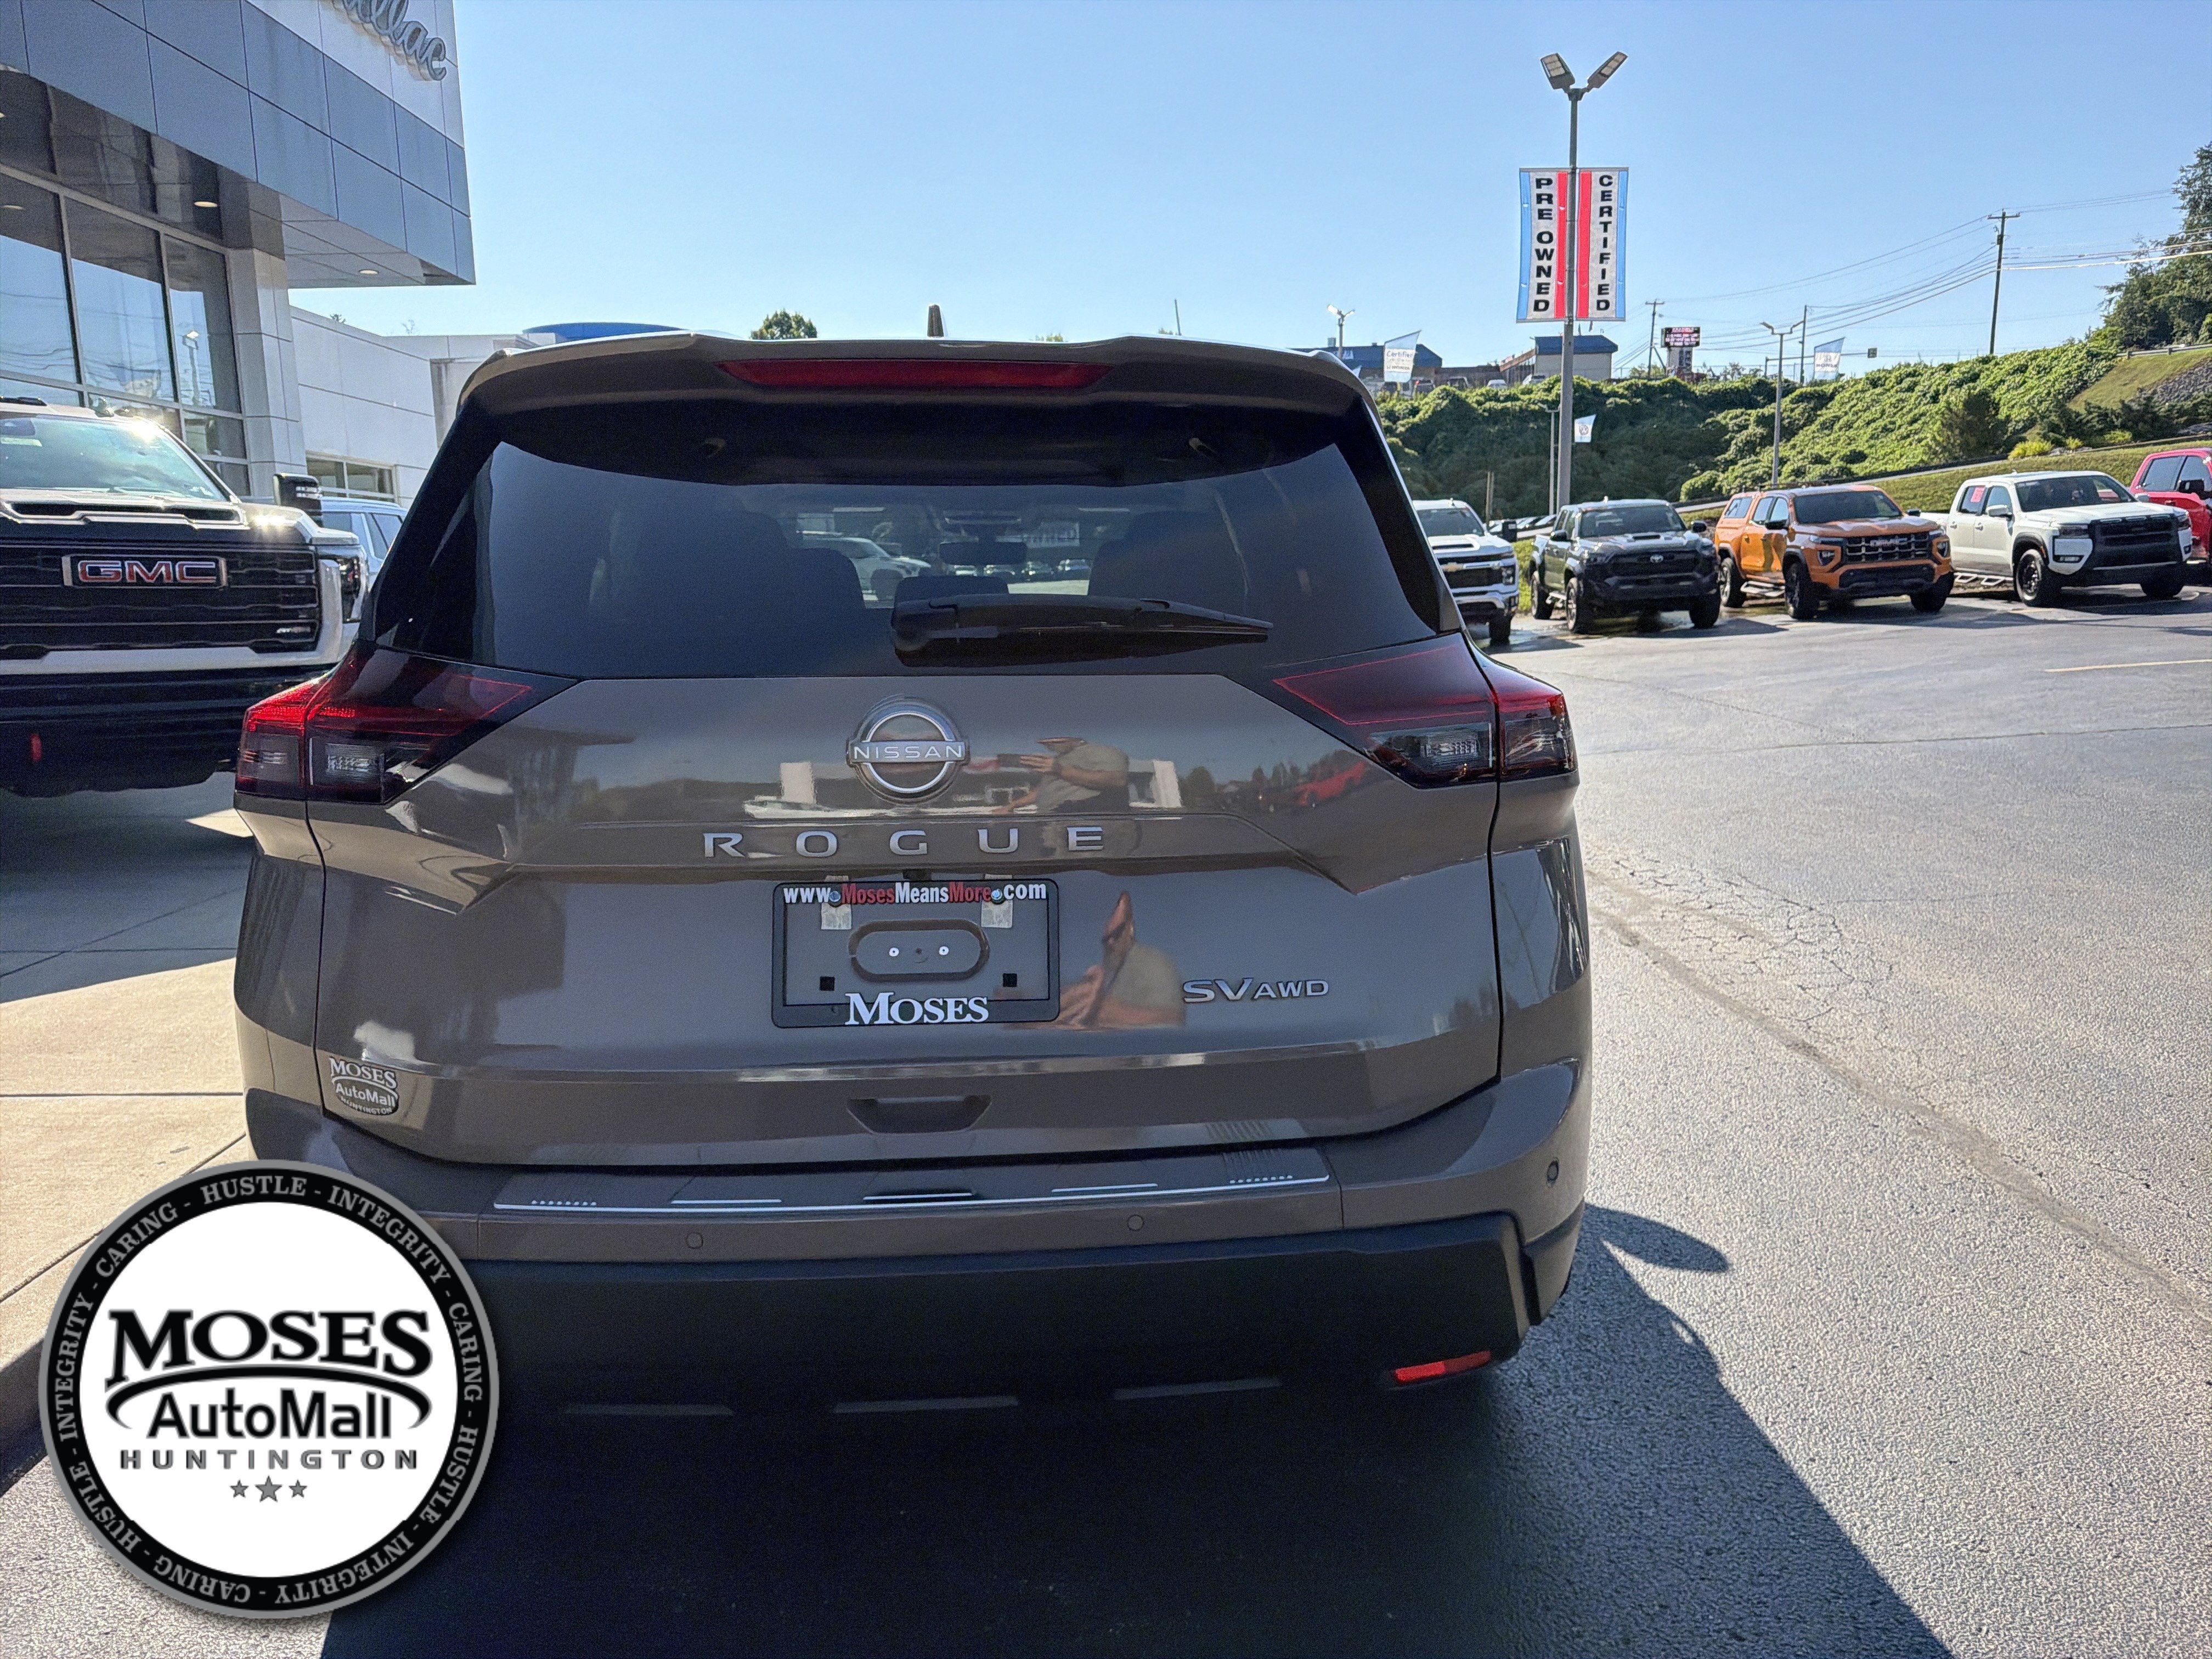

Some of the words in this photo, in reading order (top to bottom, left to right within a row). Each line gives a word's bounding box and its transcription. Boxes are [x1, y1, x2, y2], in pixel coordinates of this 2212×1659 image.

[1536, 177, 1553, 220] PRE
[1595, 174, 1613, 311] CERTIFIED
[1533, 231, 1554, 312] OWNED
[77, 560, 217, 583] GMC
[854, 744, 962, 759] NISSAN
[703, 826, 1104, 859] ROGUE
[844, 992, 989, 1026] MOSES
[330, 1057, 397, 1090] MOSES
[336, 1082, 396, 1108] AutoMall
[341, 1096, 393, 1115] HUNTINGTON
